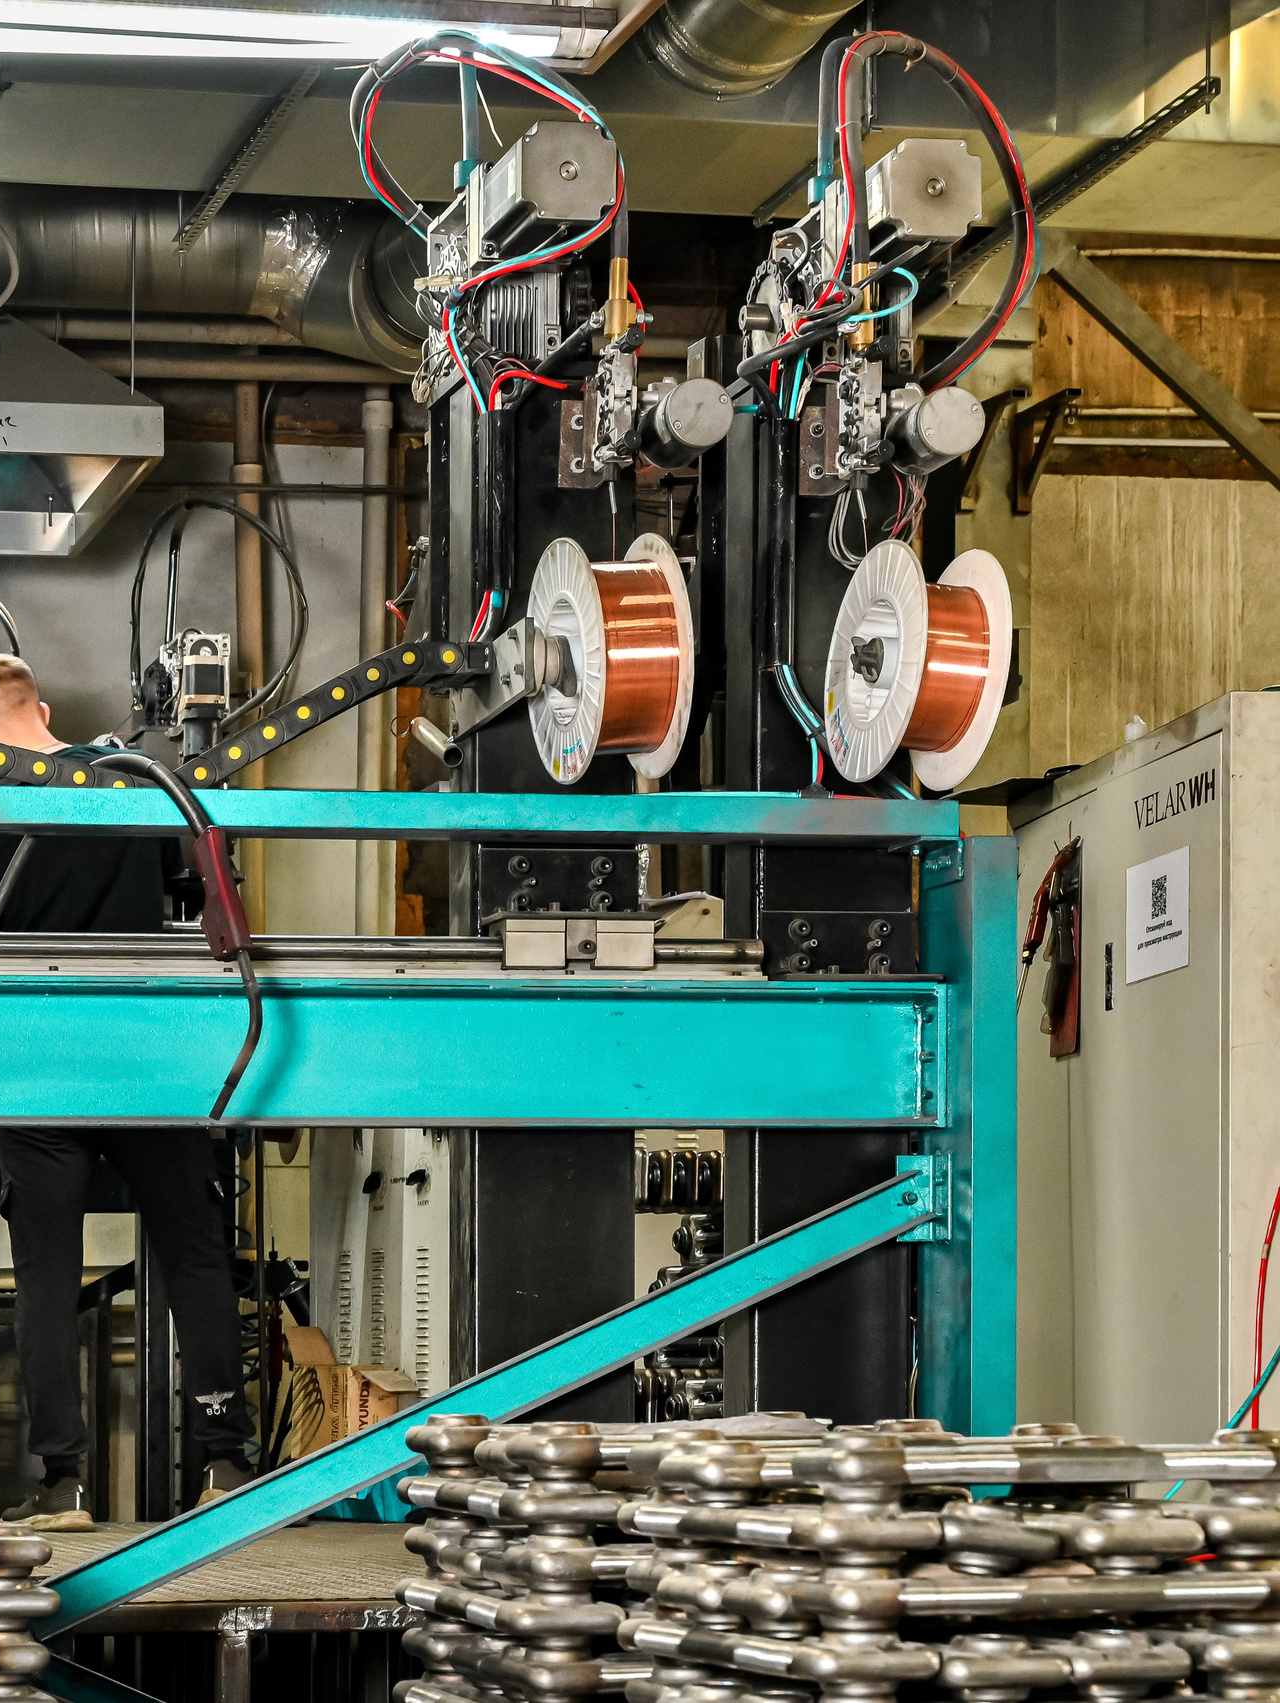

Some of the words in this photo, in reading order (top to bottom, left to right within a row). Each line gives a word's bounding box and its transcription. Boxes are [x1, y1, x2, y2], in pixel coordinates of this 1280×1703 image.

[206, 1405, 227, 1416] BOY
[358, 1374, 371, 1431] YUNDA
[331, 1416, 339, 1442] WIR
